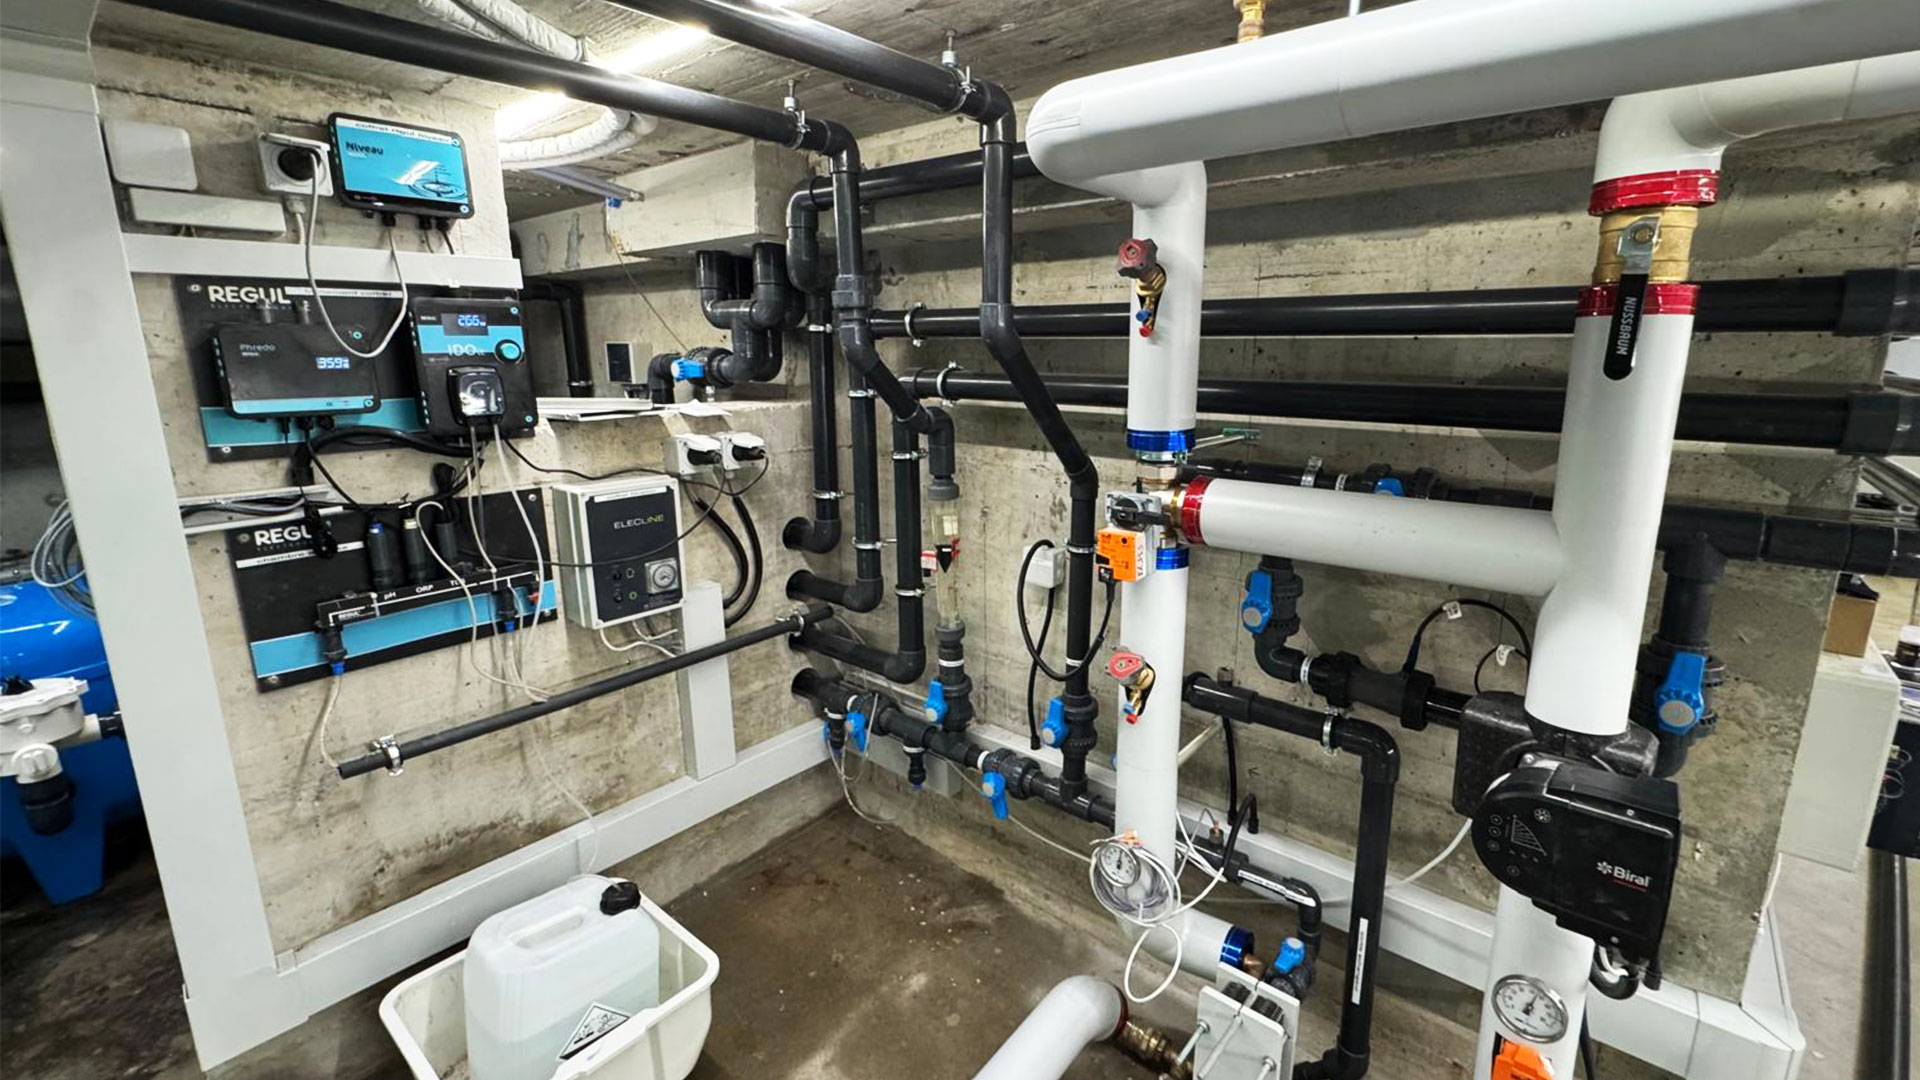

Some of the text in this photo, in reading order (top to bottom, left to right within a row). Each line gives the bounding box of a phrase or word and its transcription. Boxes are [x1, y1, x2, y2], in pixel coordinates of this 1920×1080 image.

[345, 141, 384, 155] Niveau
[207, 285, 292, 304] REGUL
[1616, 296, 1637, 355] NUSSBAUM
[613, 514, 665, 530] ELECLINE
[383, 591, 397, 601] pH
[415, 584, 434, 594] ORP
[1613, 865, 1650, 888] Biral
